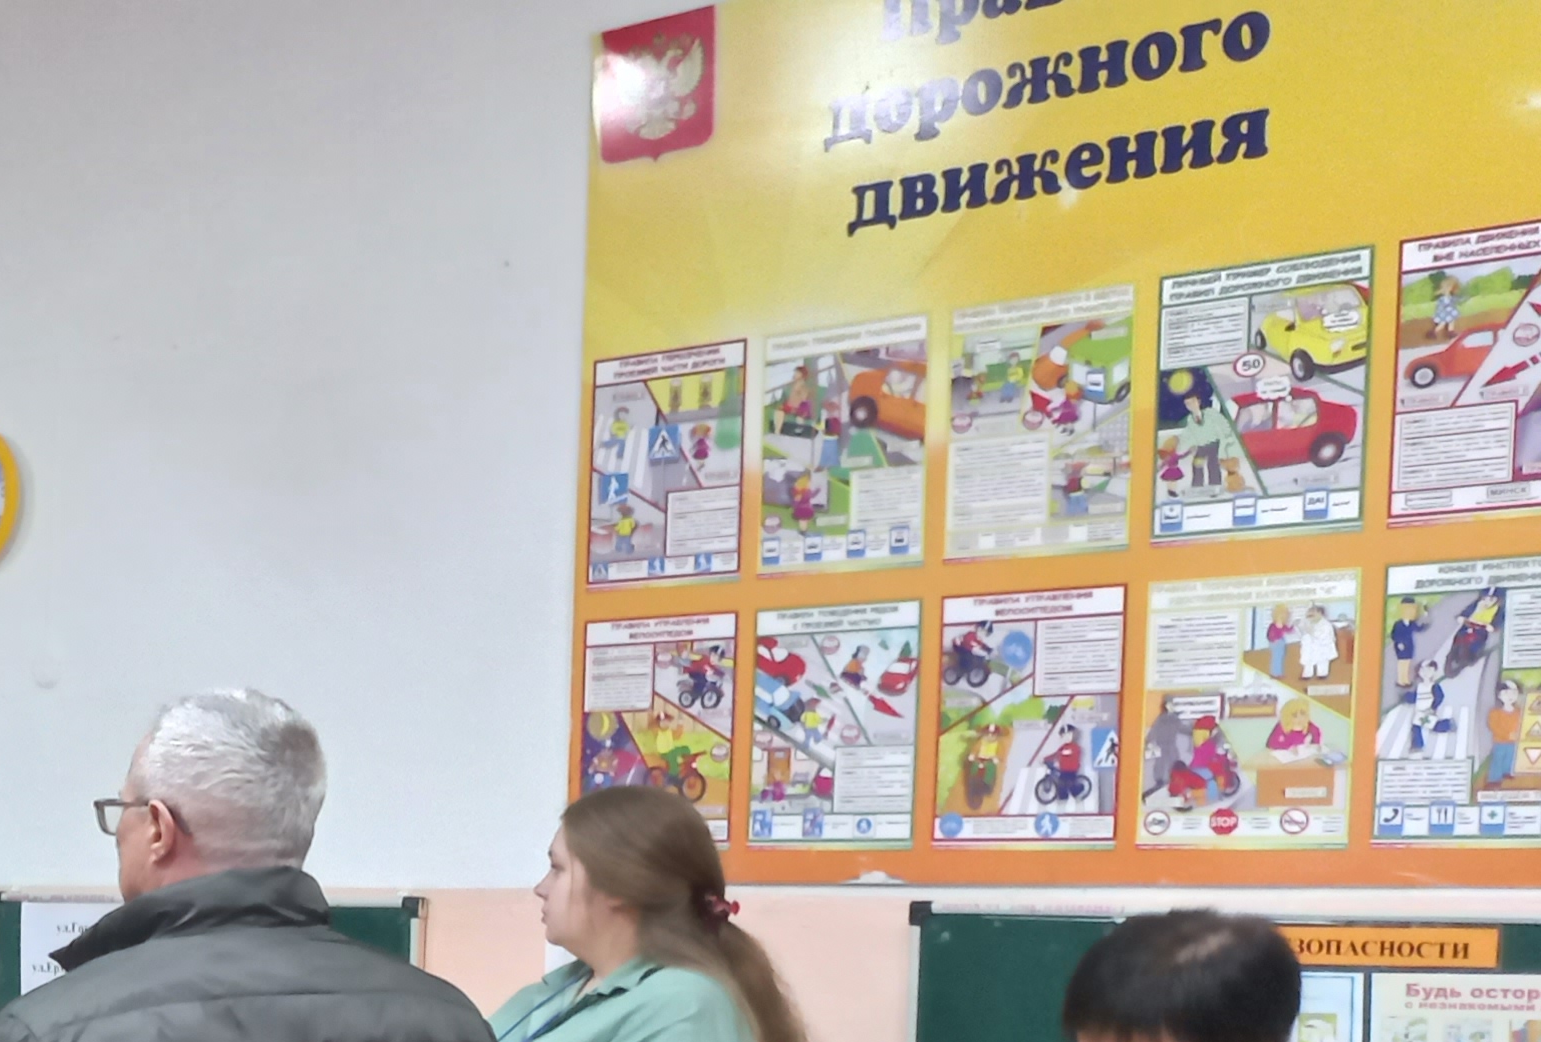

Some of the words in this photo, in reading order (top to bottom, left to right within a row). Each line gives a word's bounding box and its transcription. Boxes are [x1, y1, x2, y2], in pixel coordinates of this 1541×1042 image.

[823, 11, 1271, 153] дорожного
[846, 108, 1270, 237] движения
[1242, 358, 1260, 371] 50
[1296, 938, 1471, 960] ЗОПАСНОСТИ
[1405, 983, 1462, 1001] Будь
